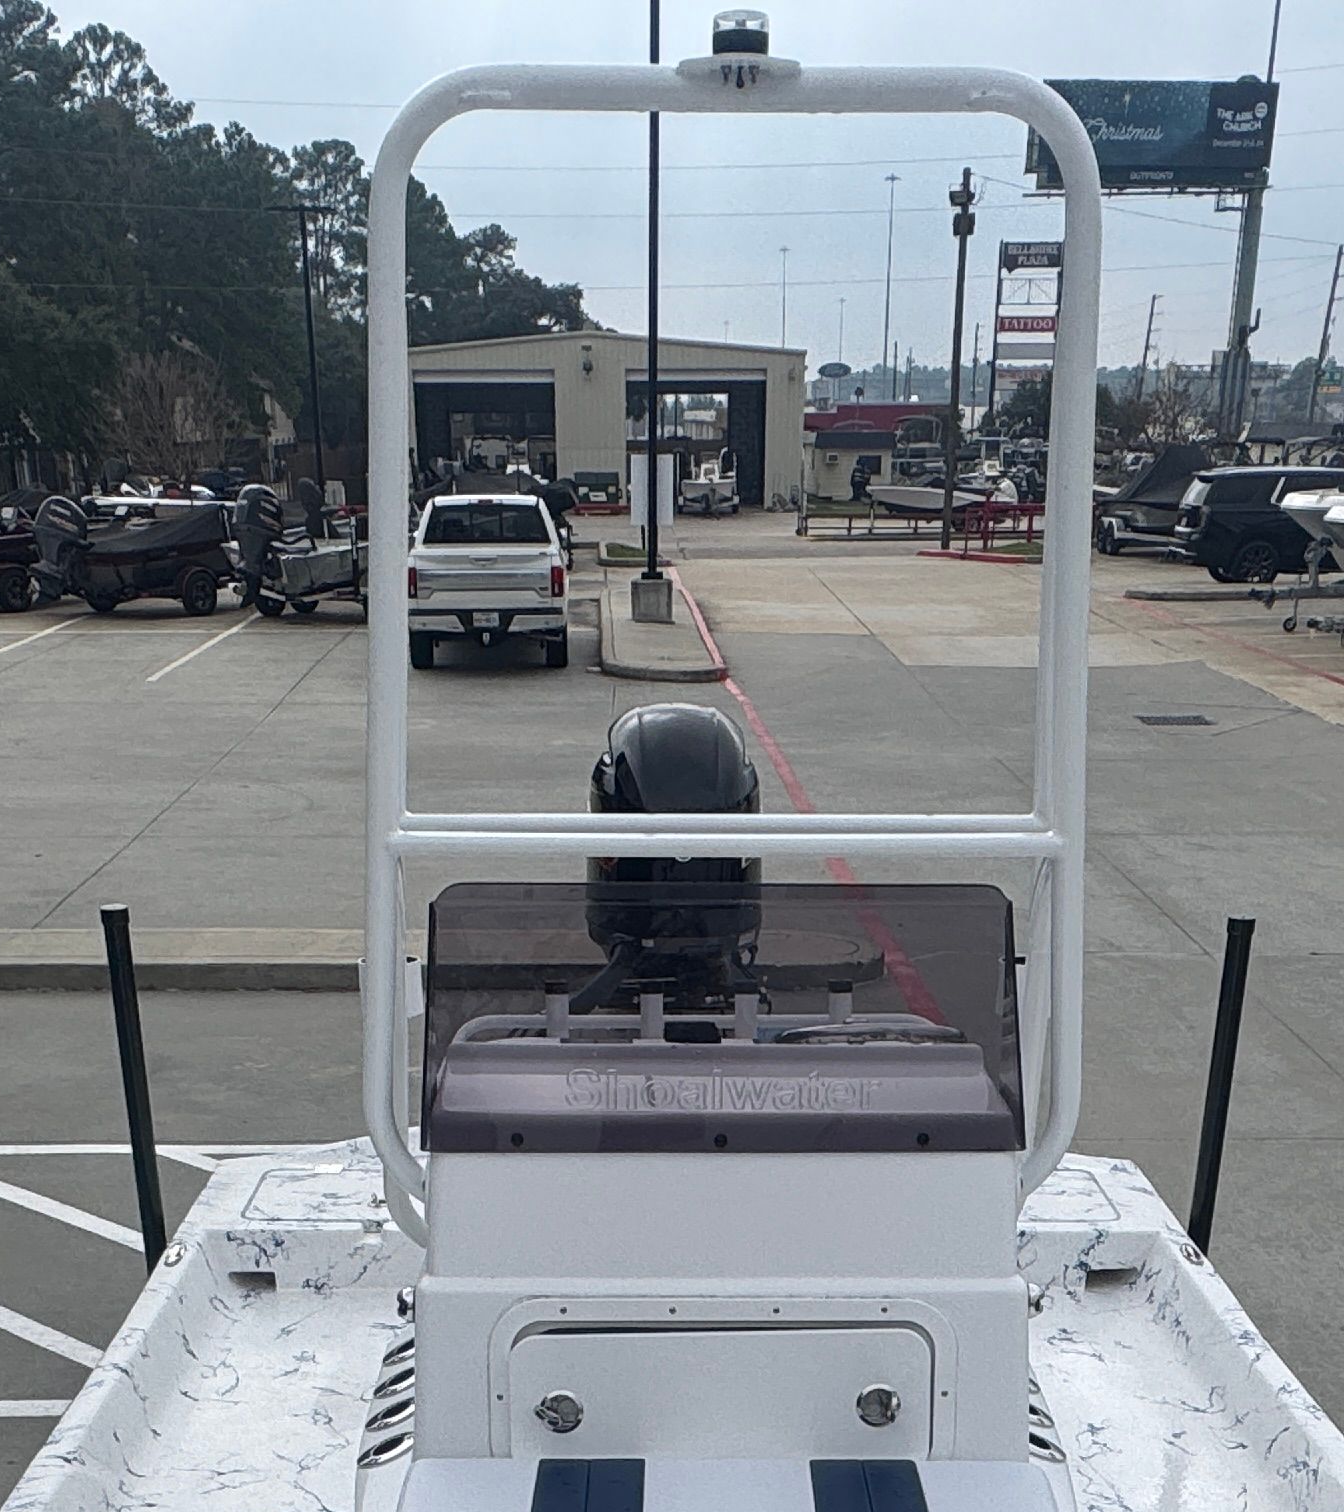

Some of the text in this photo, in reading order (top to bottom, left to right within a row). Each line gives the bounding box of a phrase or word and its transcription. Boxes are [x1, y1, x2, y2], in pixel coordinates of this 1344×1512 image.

[1083, 117, 1165, 142] Christmas
[1017, 255, 1049, 266] PLAZA
[1003, 318, 1052, 330] TATTOO
[564, 1066, 882, 1111] Shoalwater
